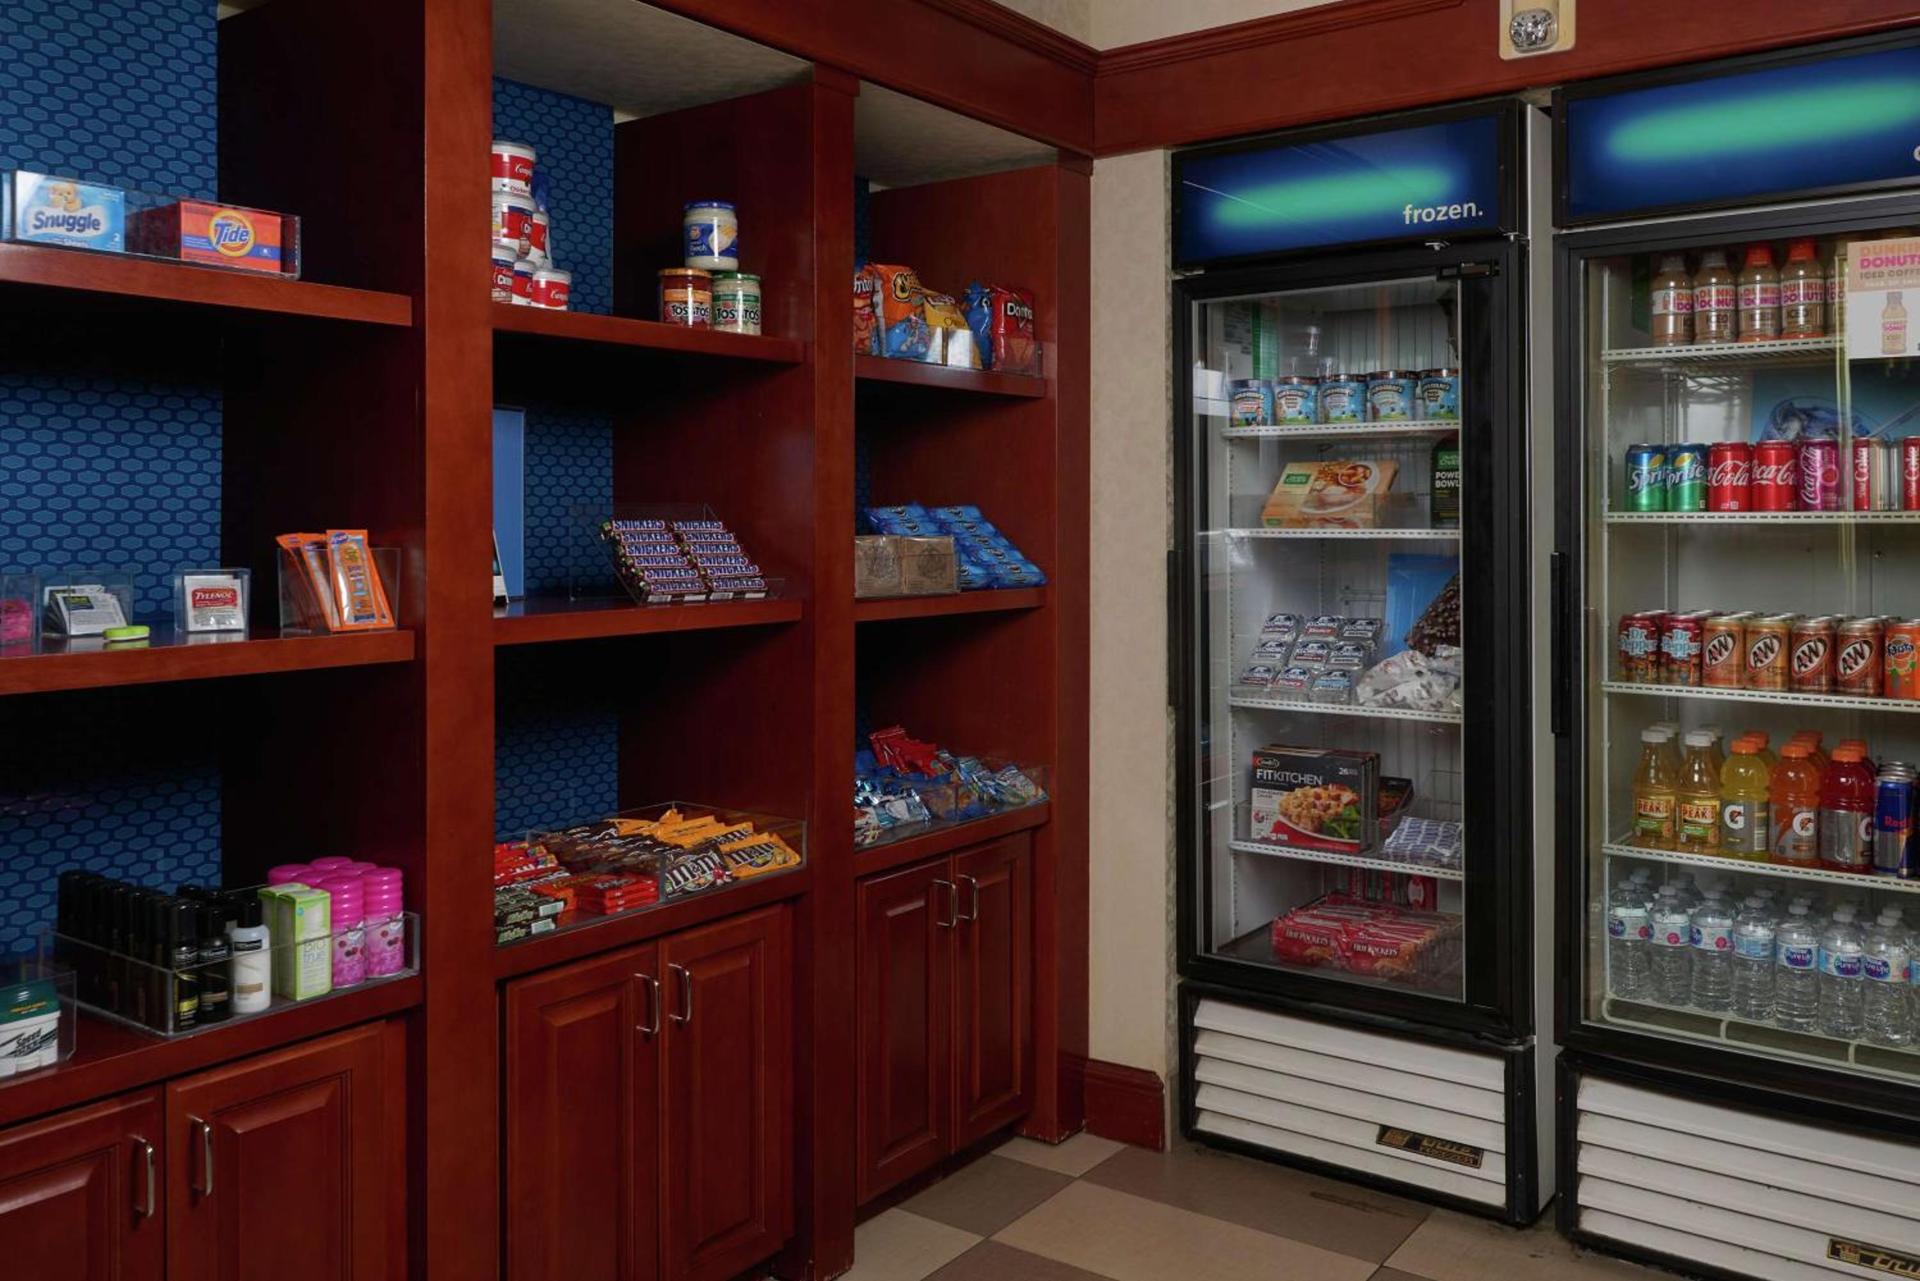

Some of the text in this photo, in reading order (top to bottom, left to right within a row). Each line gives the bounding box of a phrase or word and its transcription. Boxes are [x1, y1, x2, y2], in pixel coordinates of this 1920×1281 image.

[1403, 202, 1483, 224] frozen.
[33, 210, 101, 233] Snuggle
[214, 221, 250, 250] Tide
[1861, 271, 1885, 279] ICED
[614, 520, 663, 530] SNICKERS
[674, 521, 721, 530] SNICKERS
[623, 533, 673, 542] SNICKERS
[685, 533, 733, 542] SNICKERS
[627, 544, 678, 555] SNICKERS
[690, 543, 739, 553] SNICKERS
[635, 557, 687, 566] SNICKERS
[698, 556, 747, 565] SNICKERS
[646, 568, 697, 579] SNICKERS
[709, 565, 757, 576] SNICKERS
[653, 580, 704, 591] SNICKERS
[714, 579, 763, 589] SNICKERS
